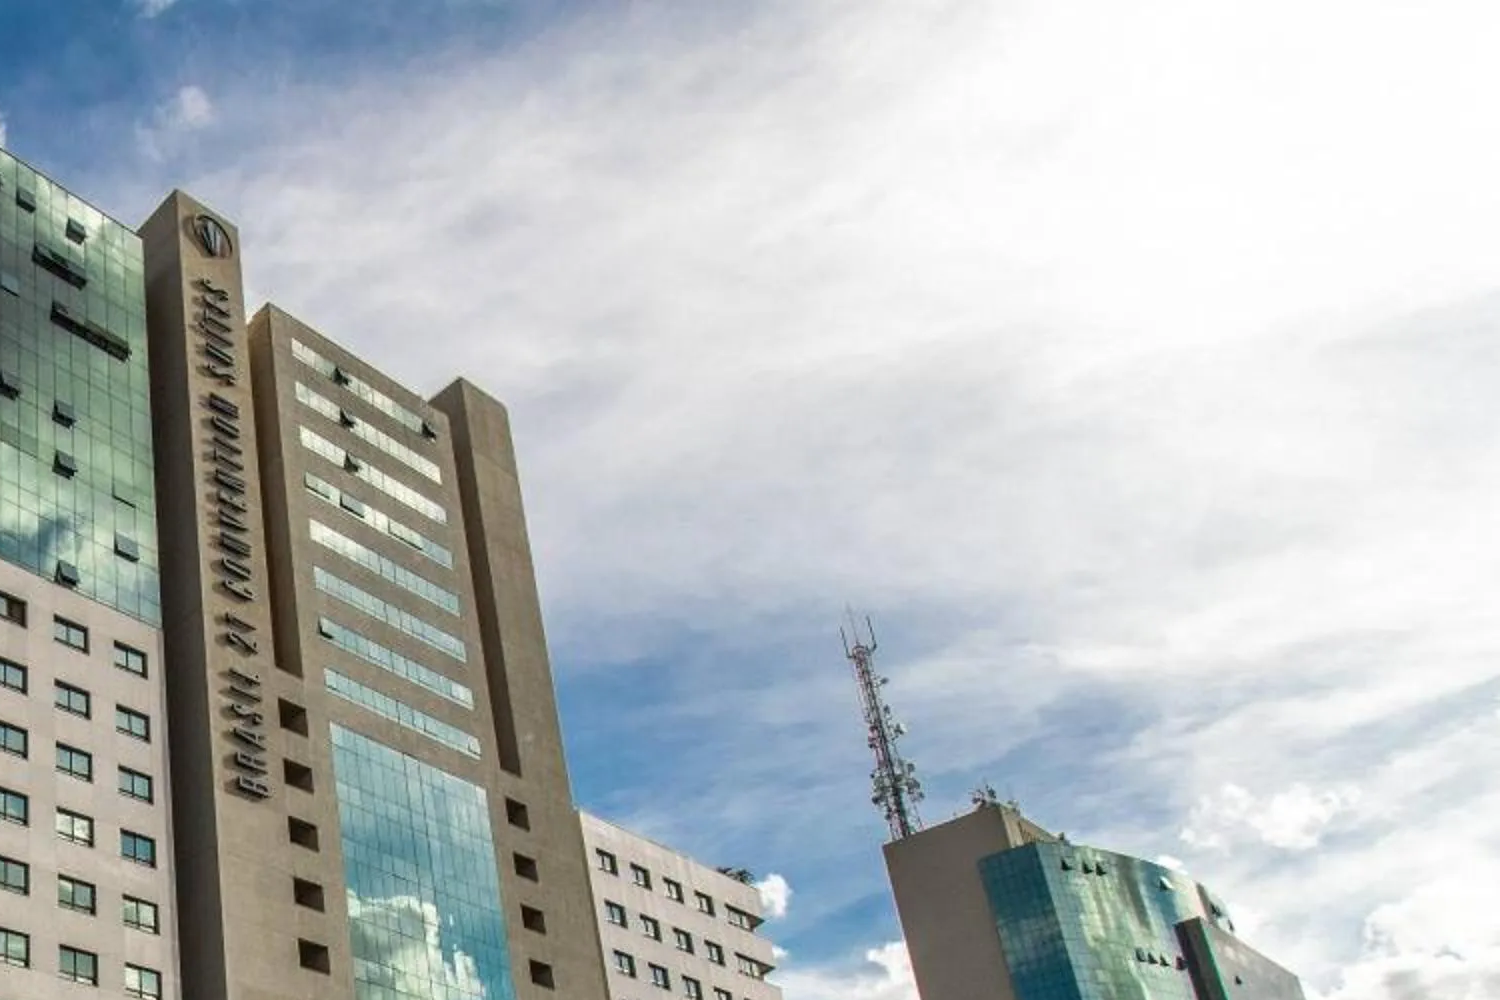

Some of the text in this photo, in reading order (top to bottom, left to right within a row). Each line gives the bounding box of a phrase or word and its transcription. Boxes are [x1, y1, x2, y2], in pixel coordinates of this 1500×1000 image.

[209, 392, 255, 601] CONVENTION
[225, 612, 259, 656] 21
[228, 667, 272, 800] BRASIL
